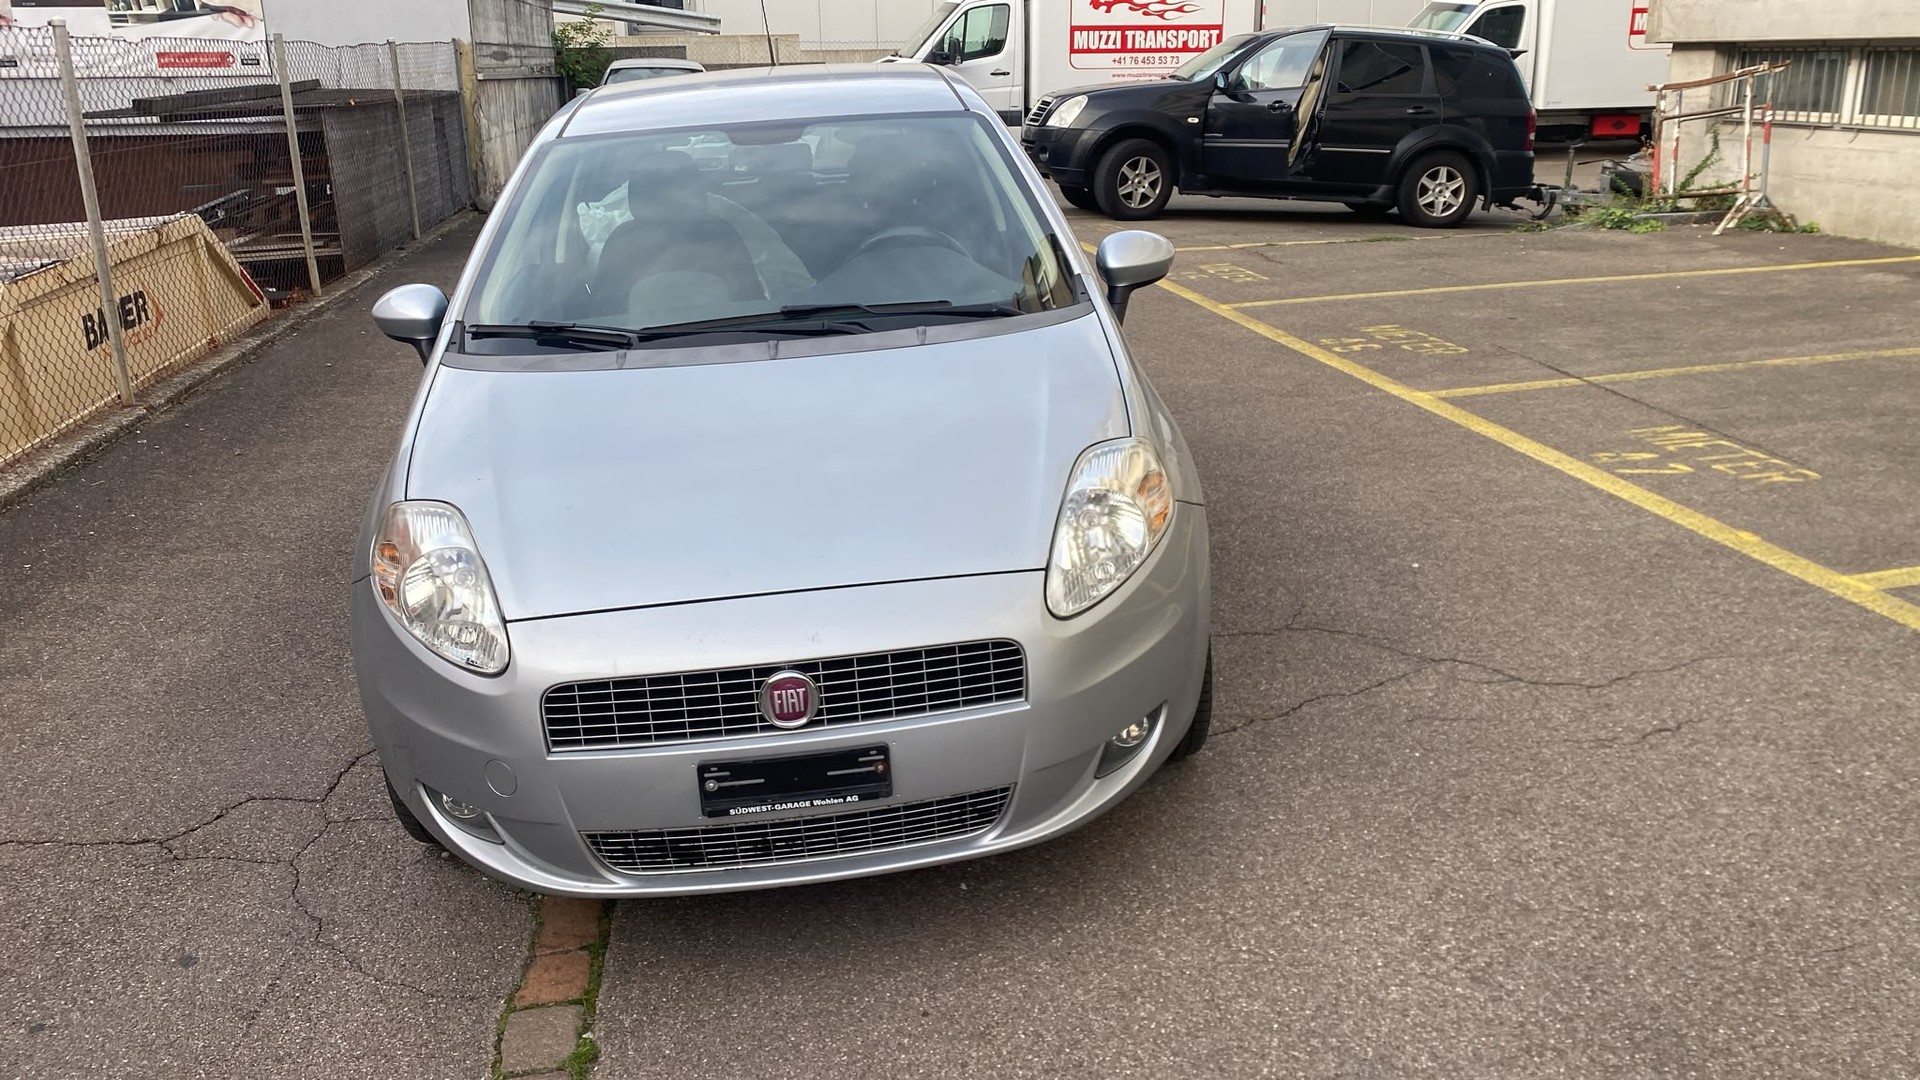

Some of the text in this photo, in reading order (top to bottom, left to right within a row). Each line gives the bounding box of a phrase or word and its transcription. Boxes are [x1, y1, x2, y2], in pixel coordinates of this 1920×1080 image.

[1073, 29, 1220, 50] MUZZI TRANSPORT
[1112, 56, 1180, 65] +41 76 453 53 73
[82, 290, 150, 351] BAER
[773, 687, 806, 714] FIAT
[729, 795, 859, 816] SÜDWEST-GARAGE Wohlen AG
